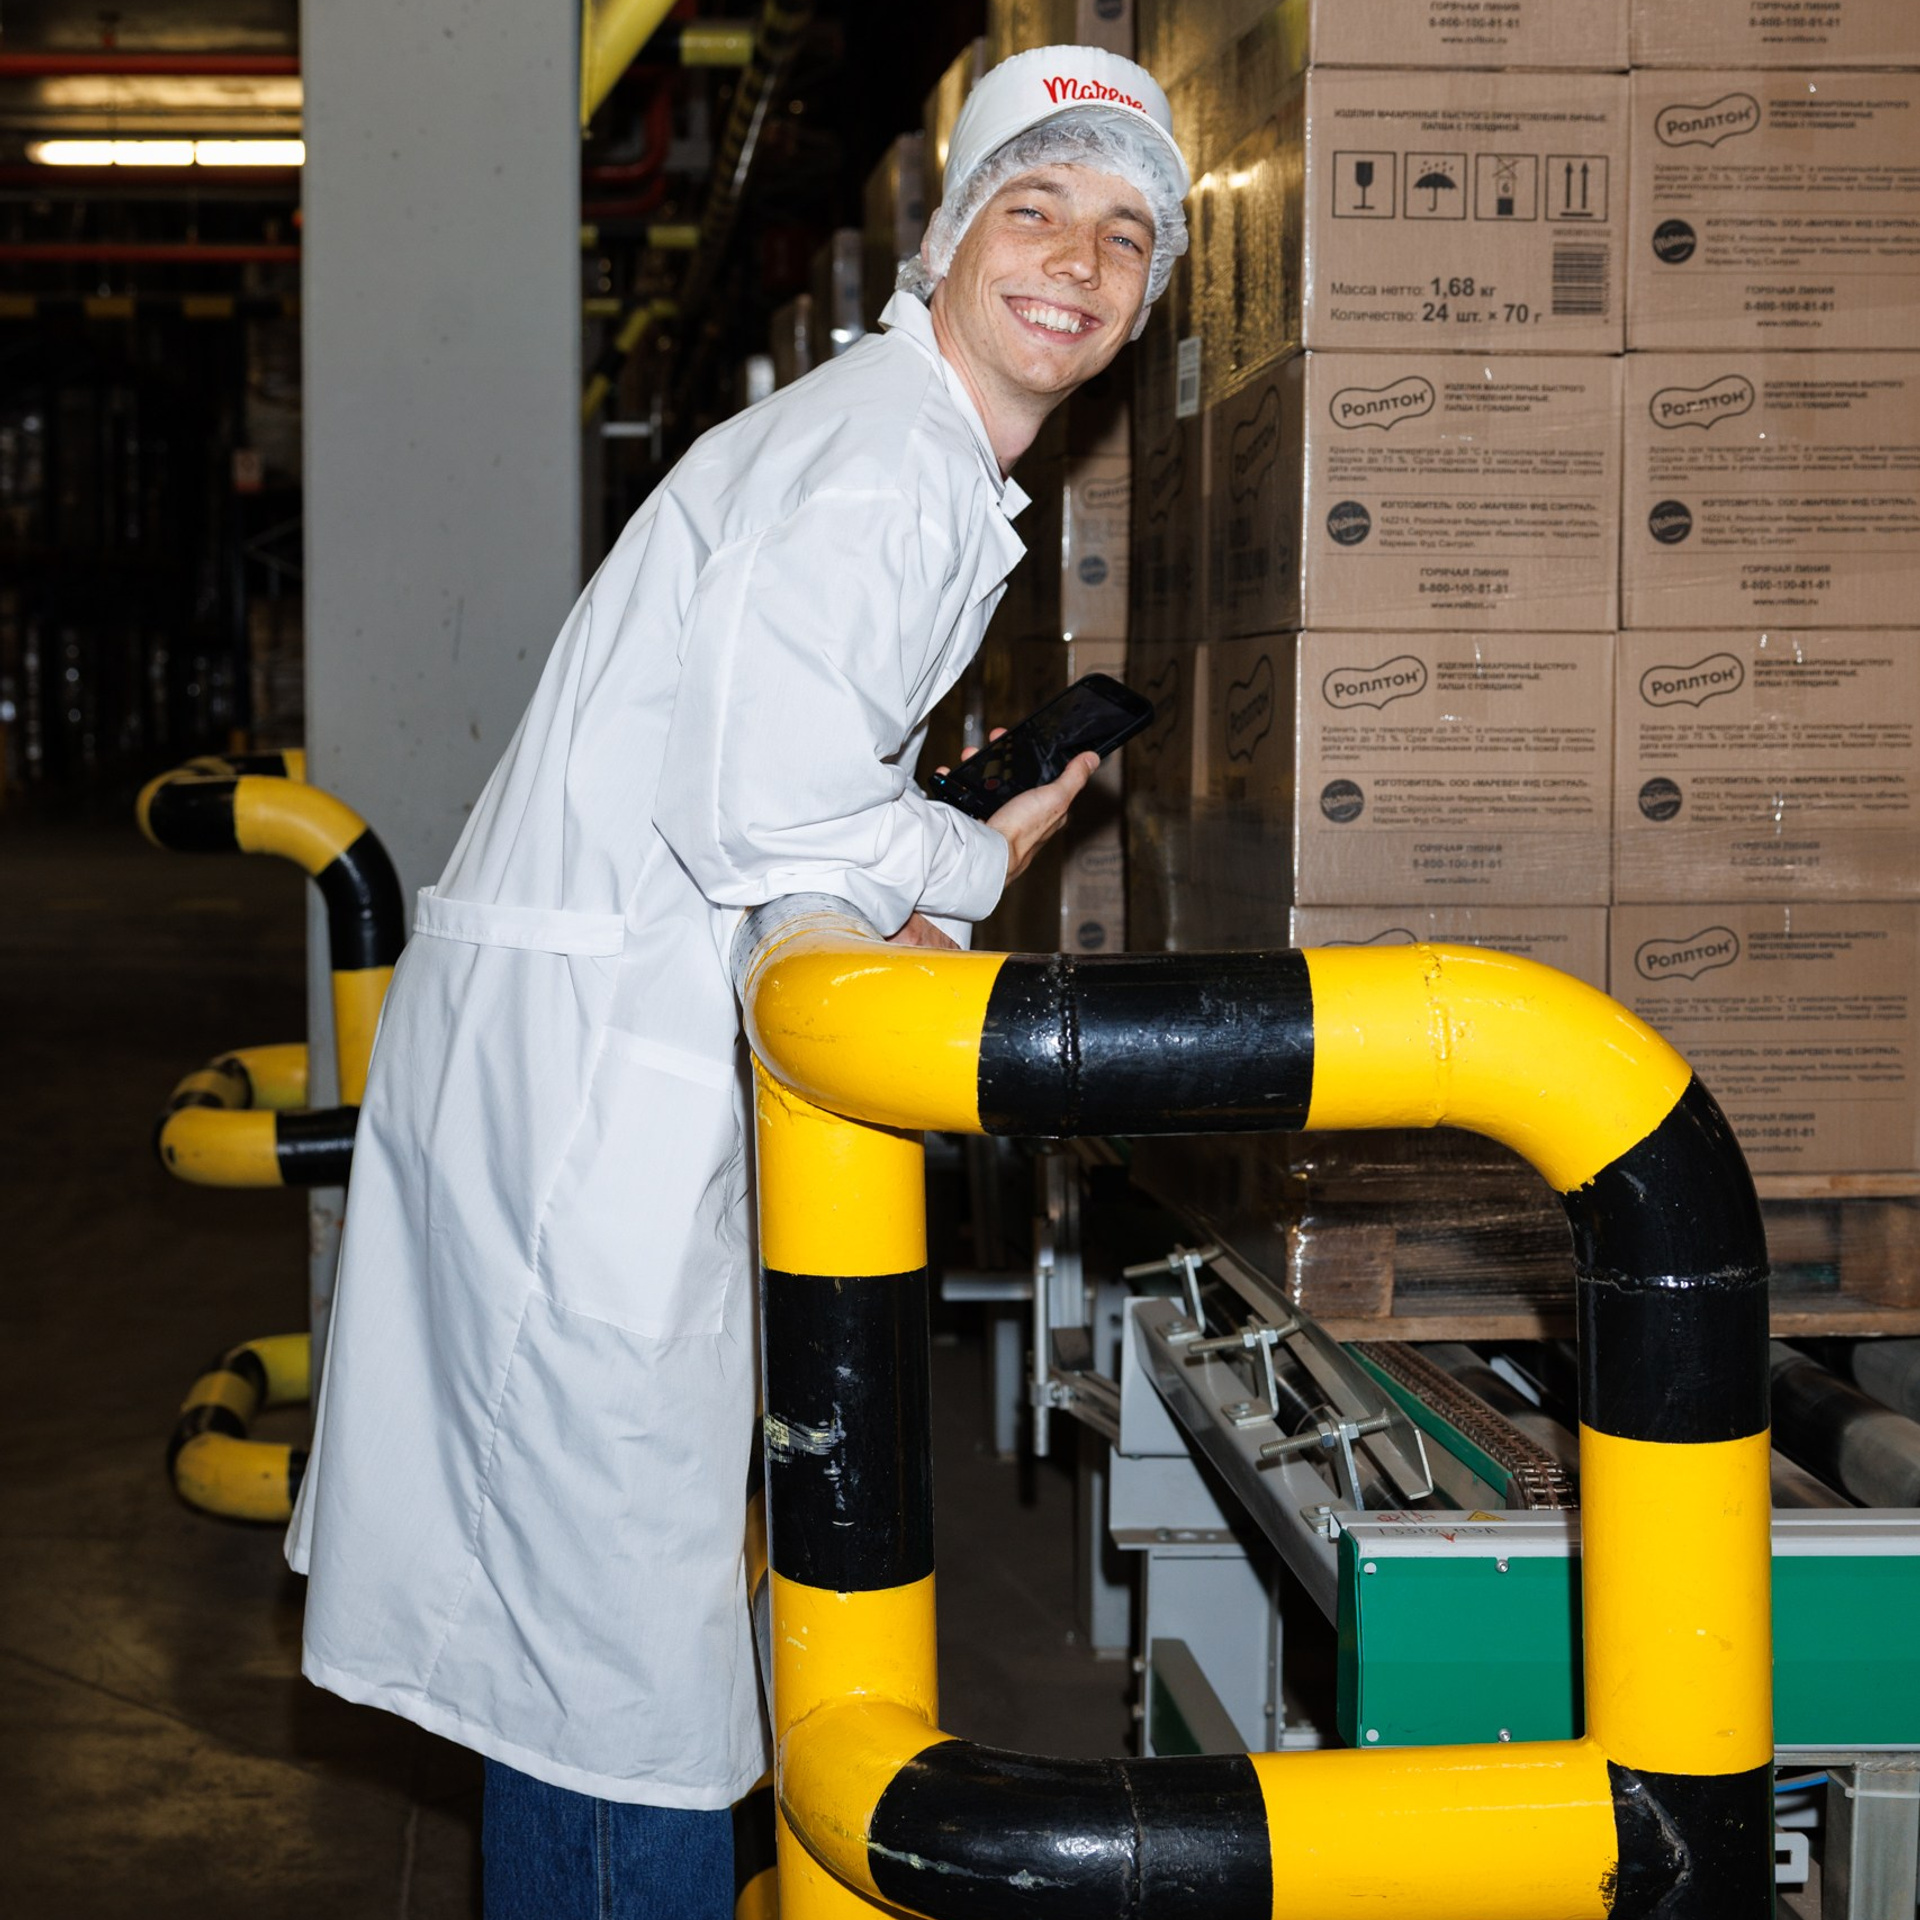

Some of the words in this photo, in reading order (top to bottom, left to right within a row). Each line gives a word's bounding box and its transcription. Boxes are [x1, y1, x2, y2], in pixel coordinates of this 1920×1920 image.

[1330, 281, 1377, 296] Масса
[1381, 285, 1425, 296] нетто:
[1430, 278, 1475, 299] 1,68
[1480, 285, 1496, 298] кг
[1330, 307, 1417, 322] Количество:
[1422, 302, 1448, 322] 24
[1456, 310, 1482, 323] шт.
[1504, 304, 1529, 323] 70
[1534, 312, 1542, 323] г
[1736, 1128, 1815, 1138] -800-100-81-81
